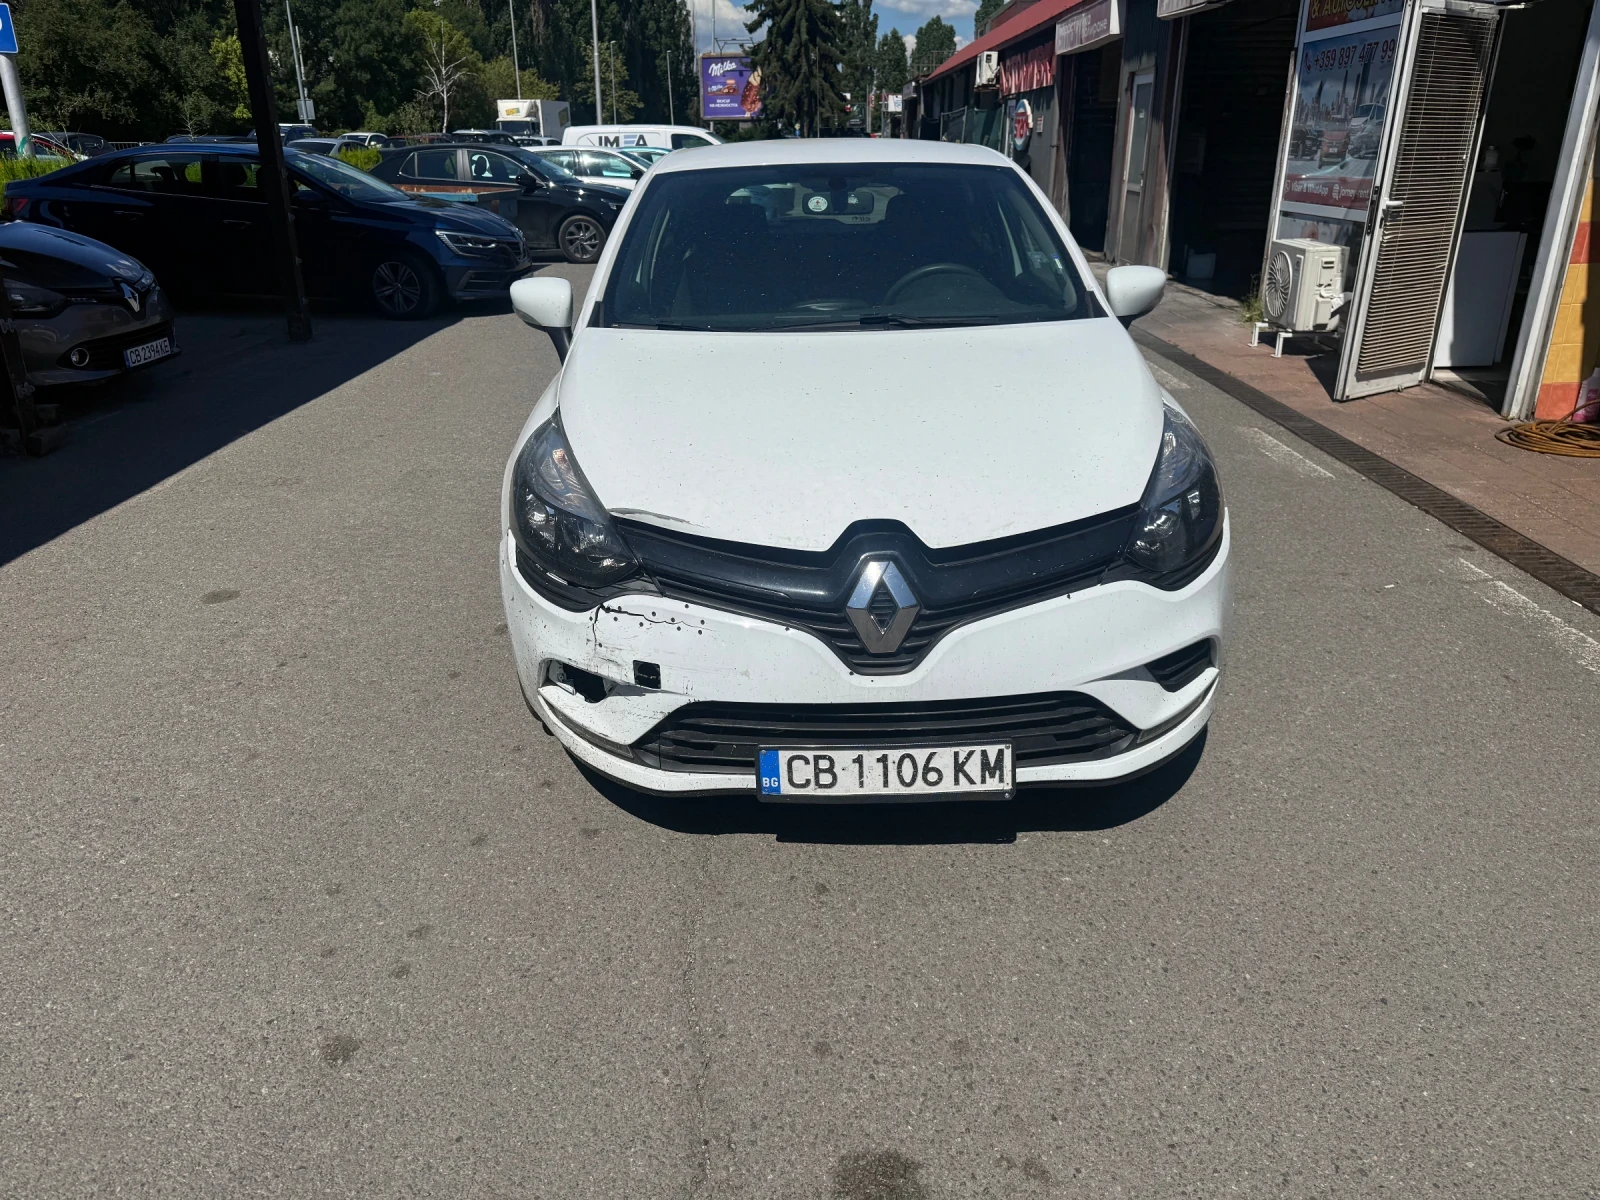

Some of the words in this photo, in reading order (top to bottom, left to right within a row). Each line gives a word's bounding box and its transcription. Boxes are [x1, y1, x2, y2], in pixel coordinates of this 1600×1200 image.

[708, 60, 737, 76] Milka
[1314, 49, 1337, 70] +359
[1338, 45, 1357, 67] 897
[129, 349, 141, 364] CB
[142, 343, 160, 361] 2394
[159, 339, 169, 355] KE
[786, 754, 838, 788] CB
[852, 751, 944, 788] 1106
[953, 748, 1006, 786] KM
[762, 777, 779, 788] BG
